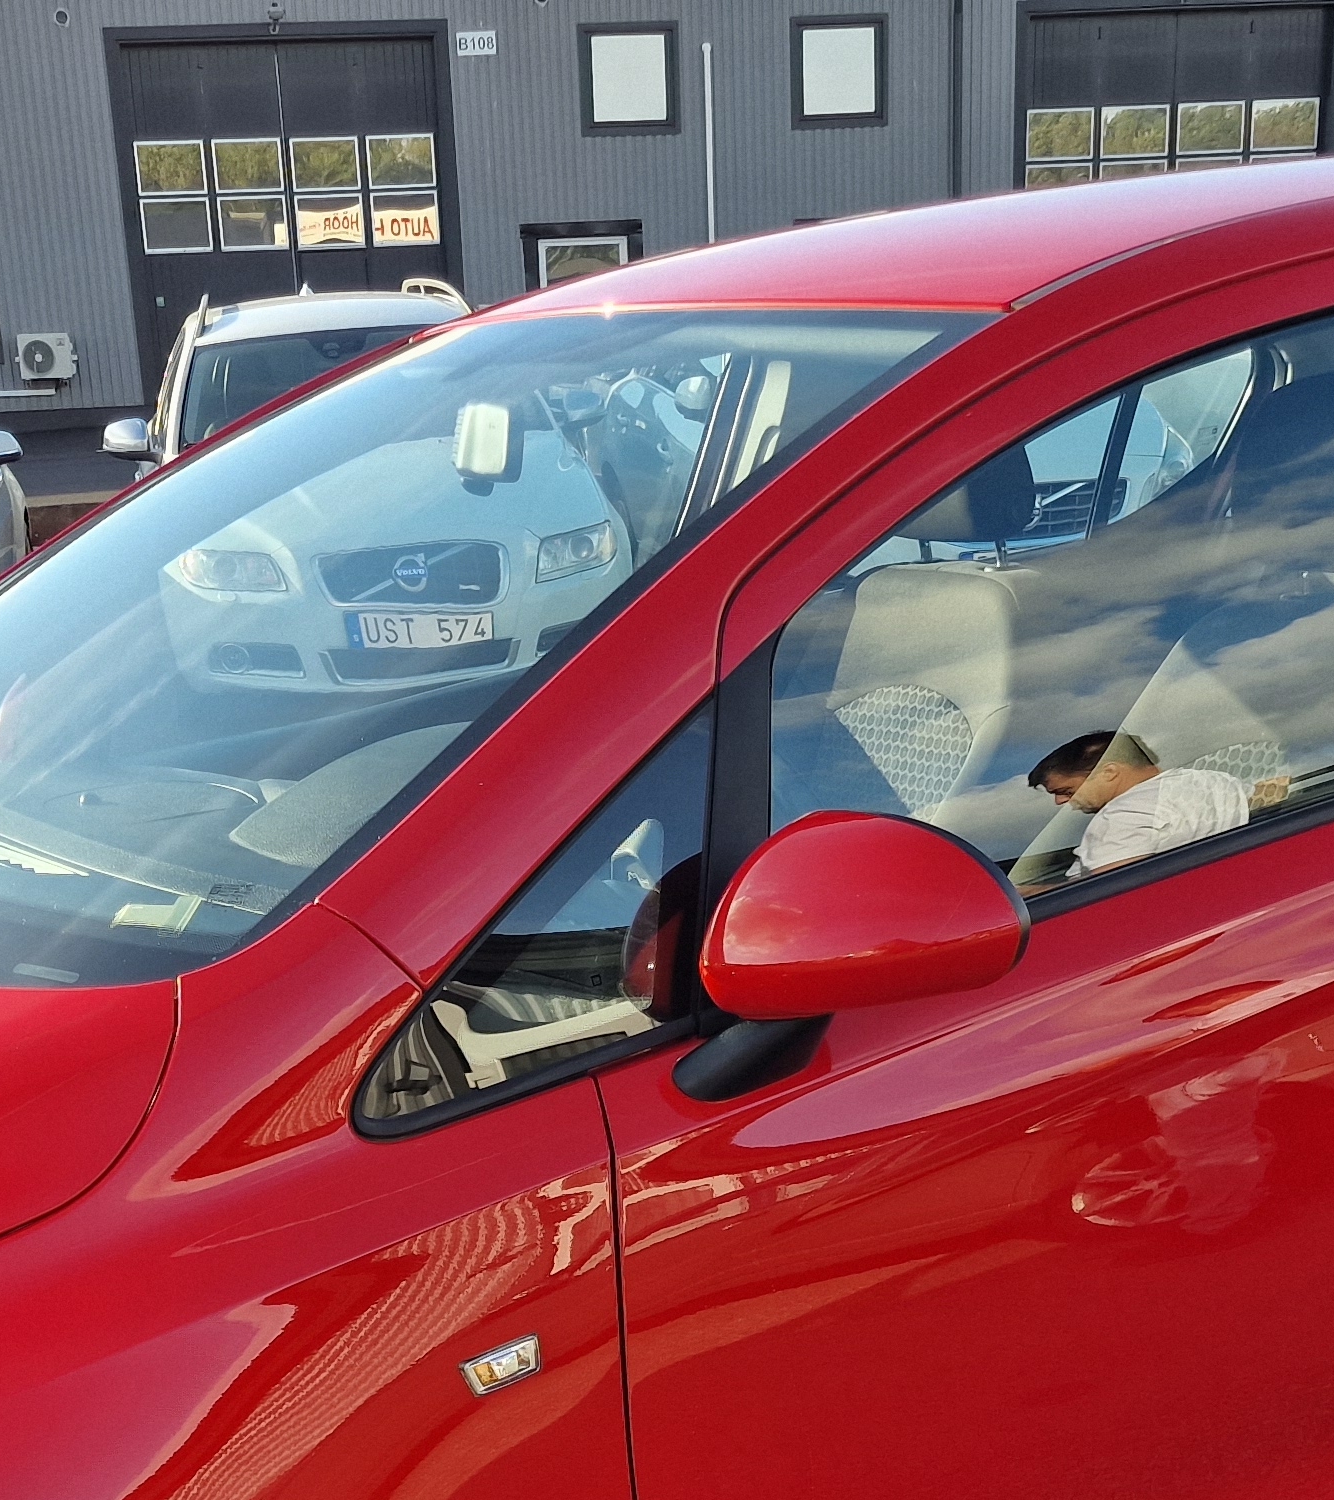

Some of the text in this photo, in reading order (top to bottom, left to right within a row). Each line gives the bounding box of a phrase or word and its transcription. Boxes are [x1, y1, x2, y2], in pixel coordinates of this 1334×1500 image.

[459, 36, 494, 50] B108
[396, 568, 425, 577] VOLVO
[363, 617, 414, 644] UST
[437, 617, 487, 643] 574
